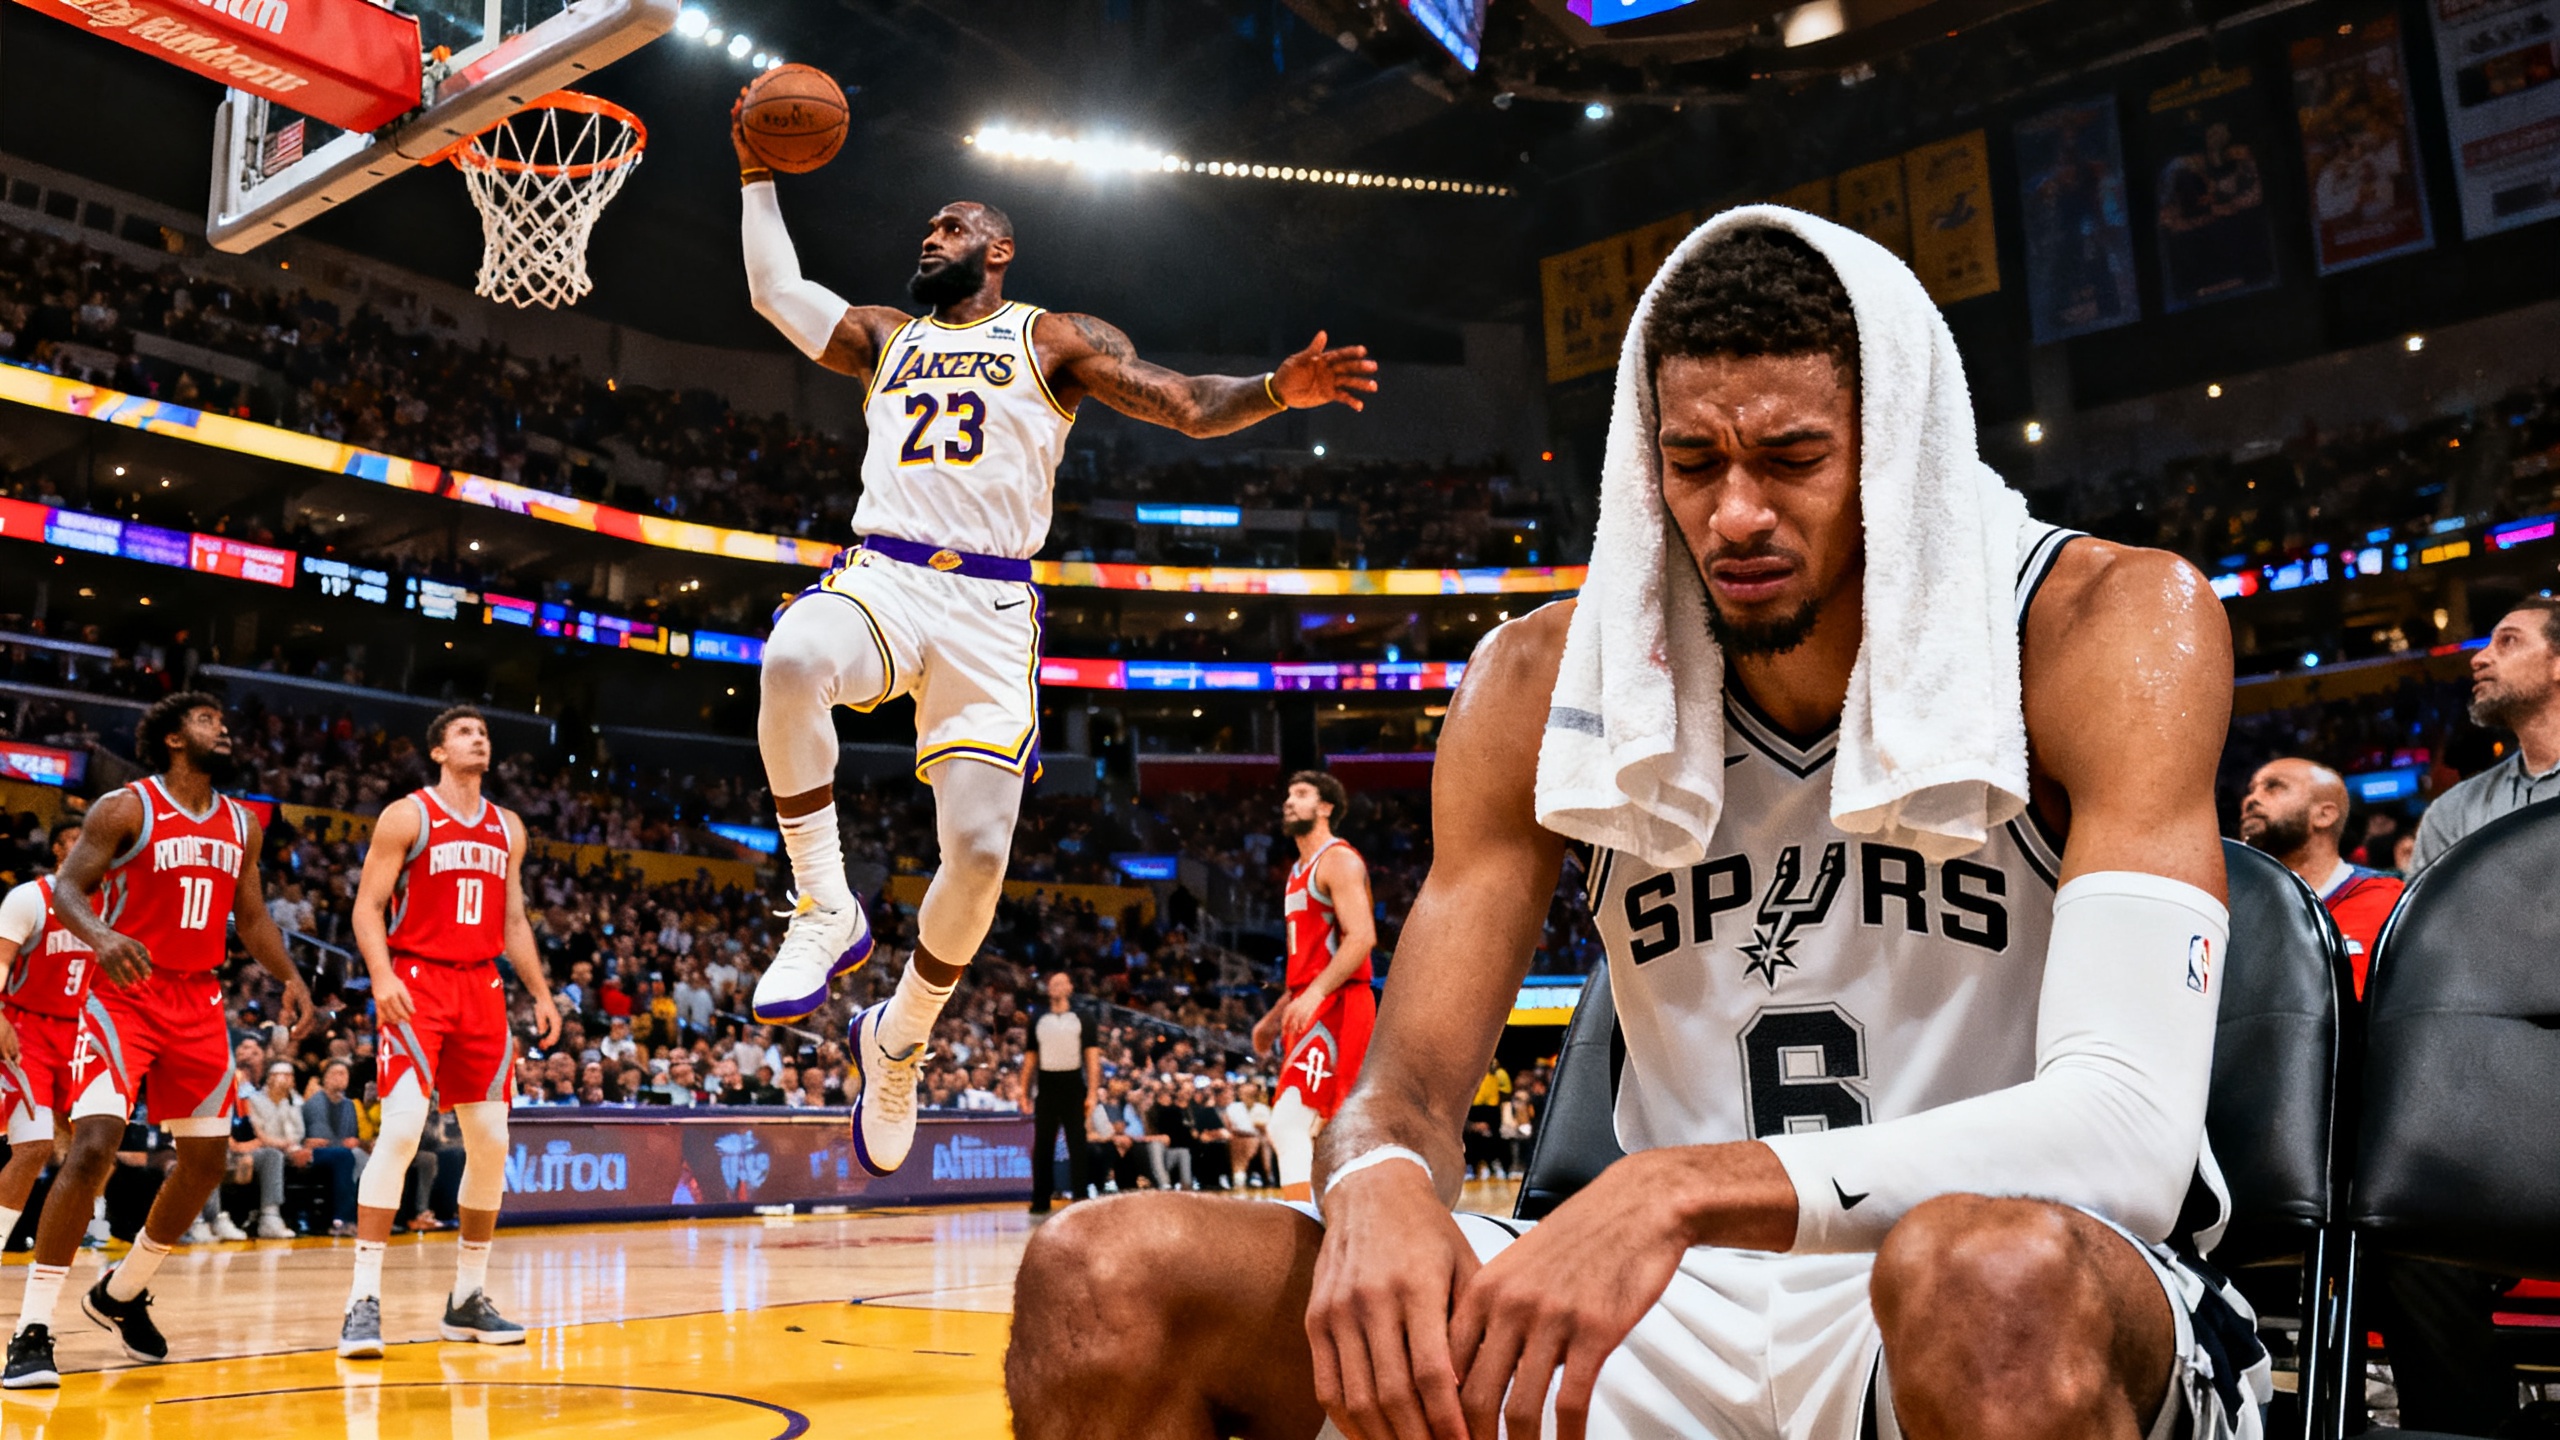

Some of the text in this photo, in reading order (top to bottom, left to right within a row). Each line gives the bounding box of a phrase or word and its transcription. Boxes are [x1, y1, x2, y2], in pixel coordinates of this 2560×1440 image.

[881, 345, 1016, 389] LAKERS
[899, 388, 986, 468] 23
[179, 875, 213, 931] 10
[1624, 842, 2010, 992] SPURS
[1737, 1001, 1873, 1139] 6
